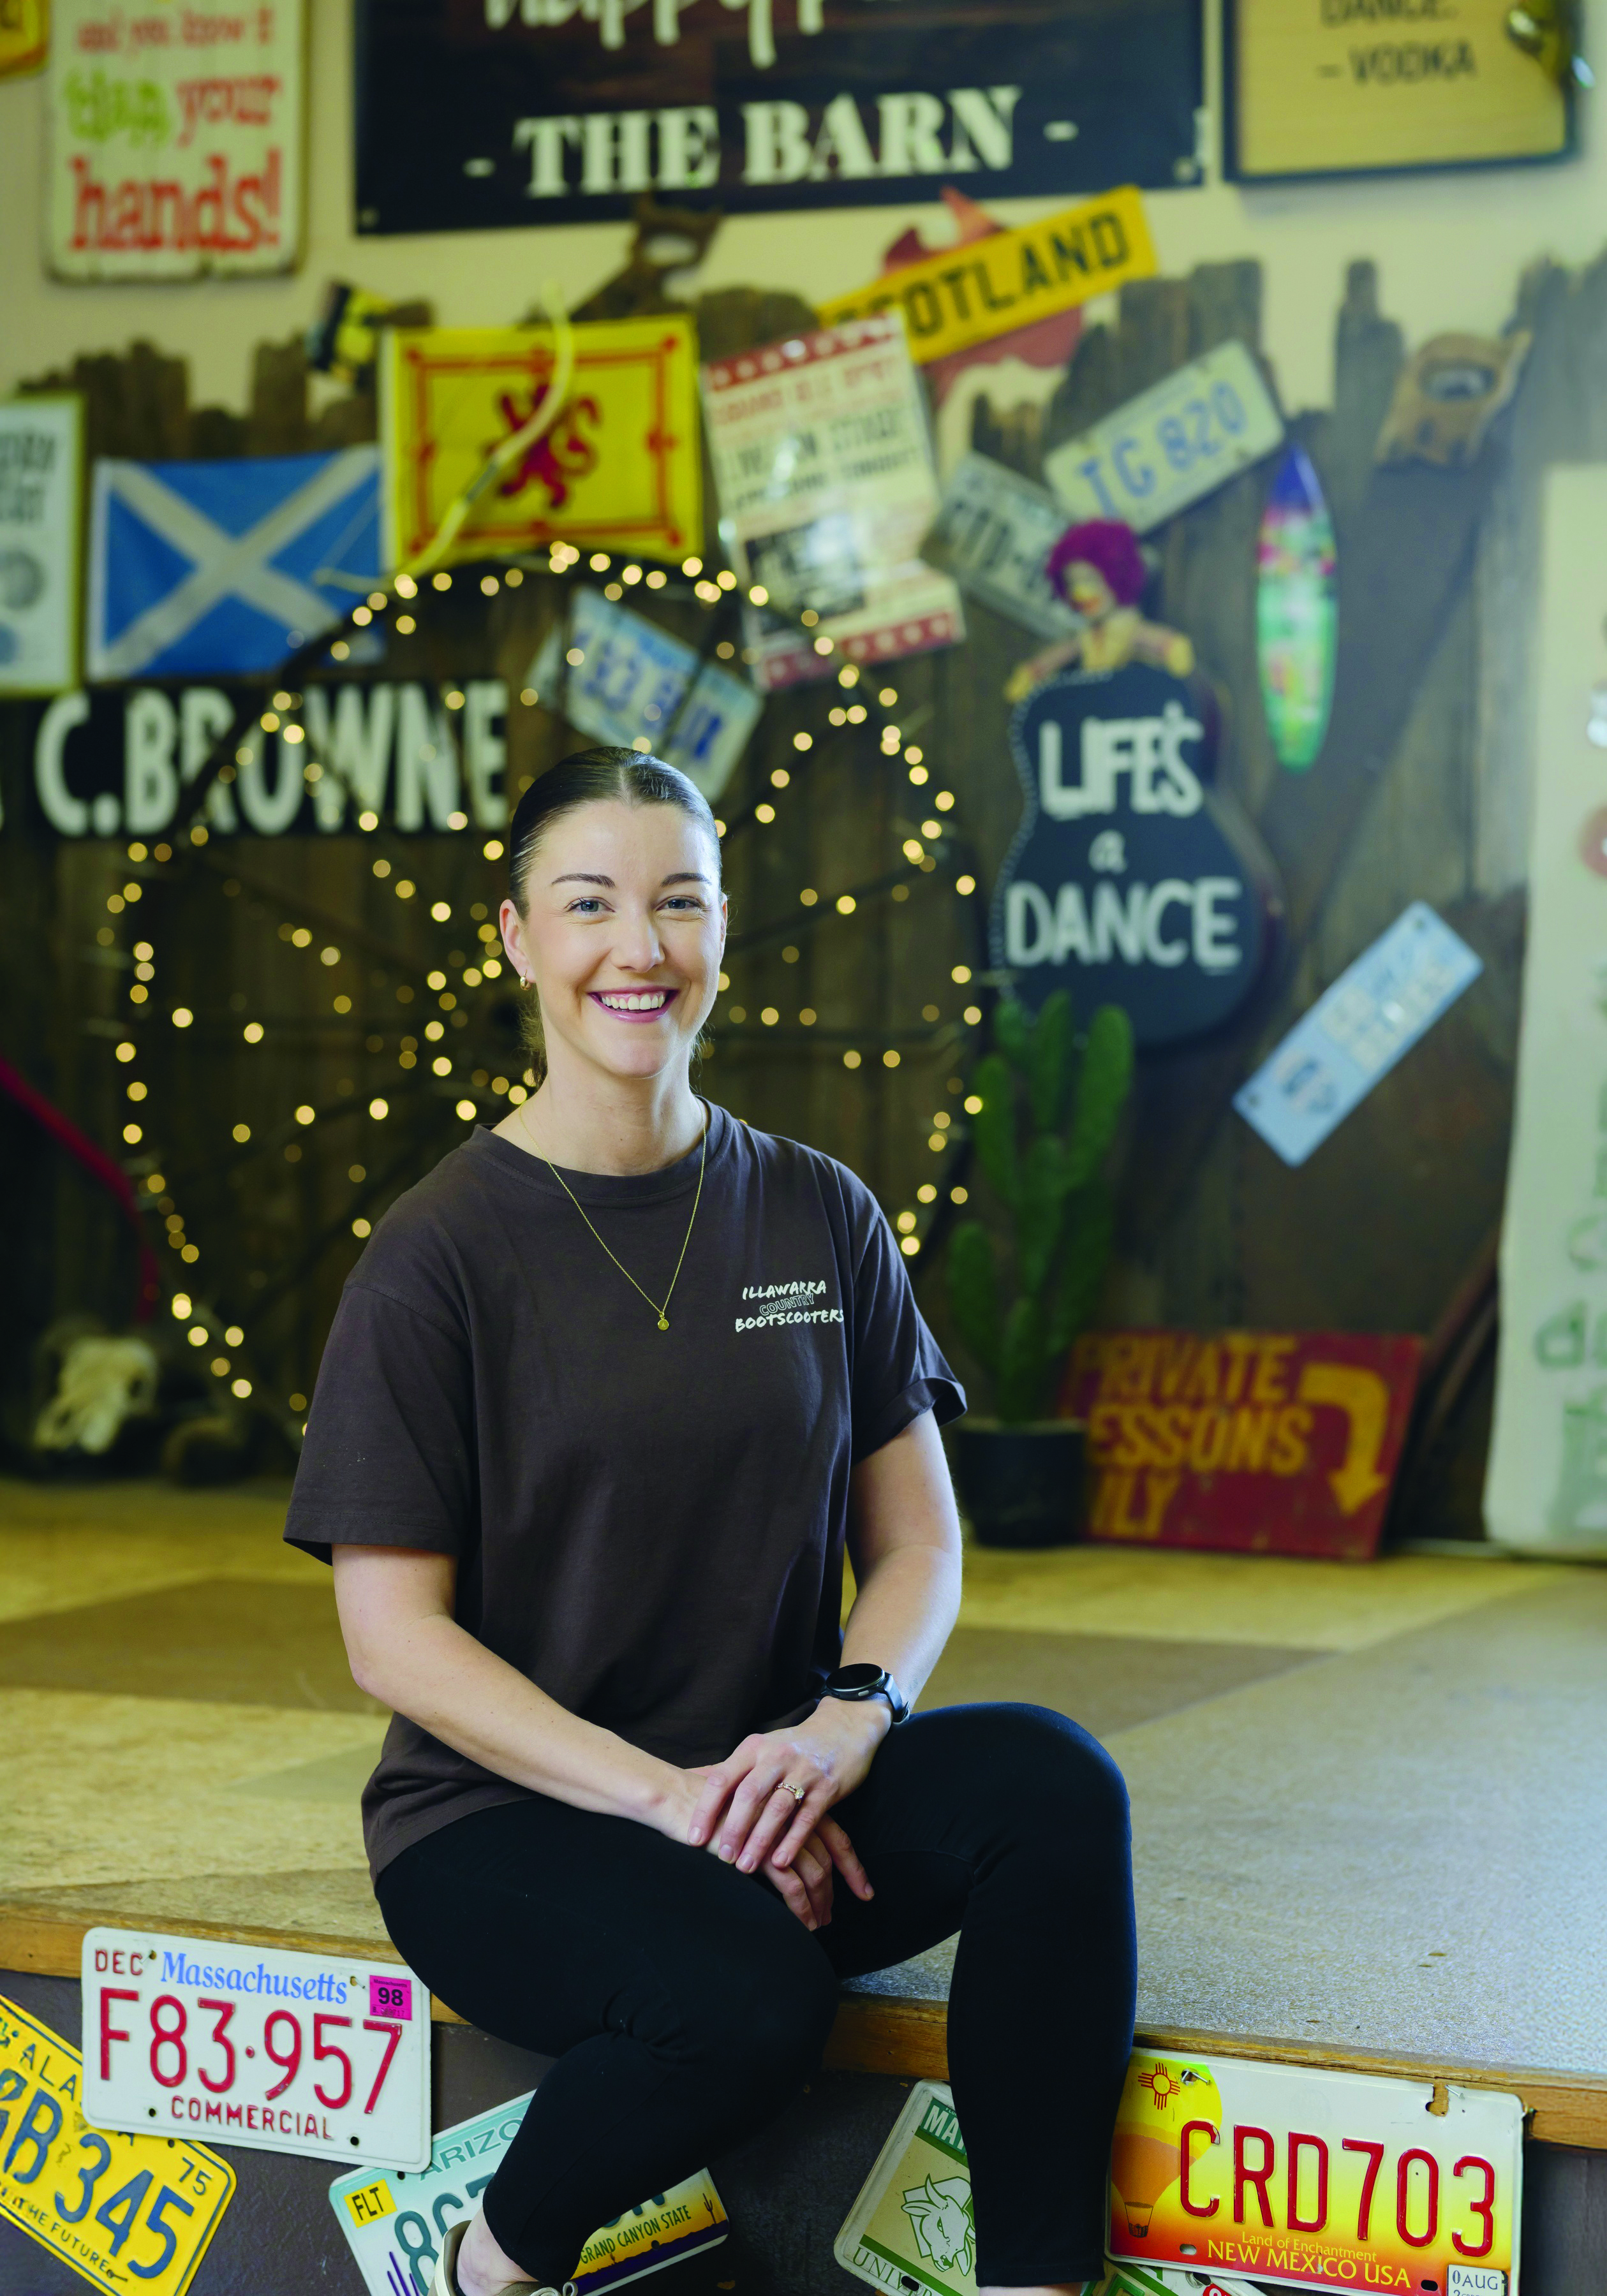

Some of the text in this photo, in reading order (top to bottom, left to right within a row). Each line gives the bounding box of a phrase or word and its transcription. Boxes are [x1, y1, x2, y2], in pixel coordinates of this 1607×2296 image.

[1348, 38, 1477, 87] VODKA
[512, 105, 720, 198] THE
[741, 84, 1021, 186] BARN
[67, 145, 282, 253] hands!
[833, 210, 1130, 338] OTLAND
[1087, 828, 1129, 874] a
[1005, 876, 1243, 976] DANCE
[742, 1279, 827, 1300] ILLAWARRA
[759, 1292, 815, 1316] COUNTRY
[1067, 1330, 1298, 1406] PRIVATE
[1088, 1400, 1315, 1478] ESSONS
[94, 1948, 347, 2005] DEC Massachusetts
[378, 1987, 404, 2007] 98
[170, 2095, 335, 2140] COMMERCIAL
[179, 2156, 213, 2196] 75
[1180, 2119, 1495, 2258] CRD703
[352, 2186, 384, 2221] FLT
[50, 2221, 110, 2272] FUTURE
[580, 2237, 616, 2265] GRAND
[616, 2217, 662, 2248] CANYON
[660, 2204, 692, 2230] STATE
[1241, 2231, 1377, 2263] Land of Enchantment
[1207, 2239, 1412, 2289] NEW MEXICO USA
